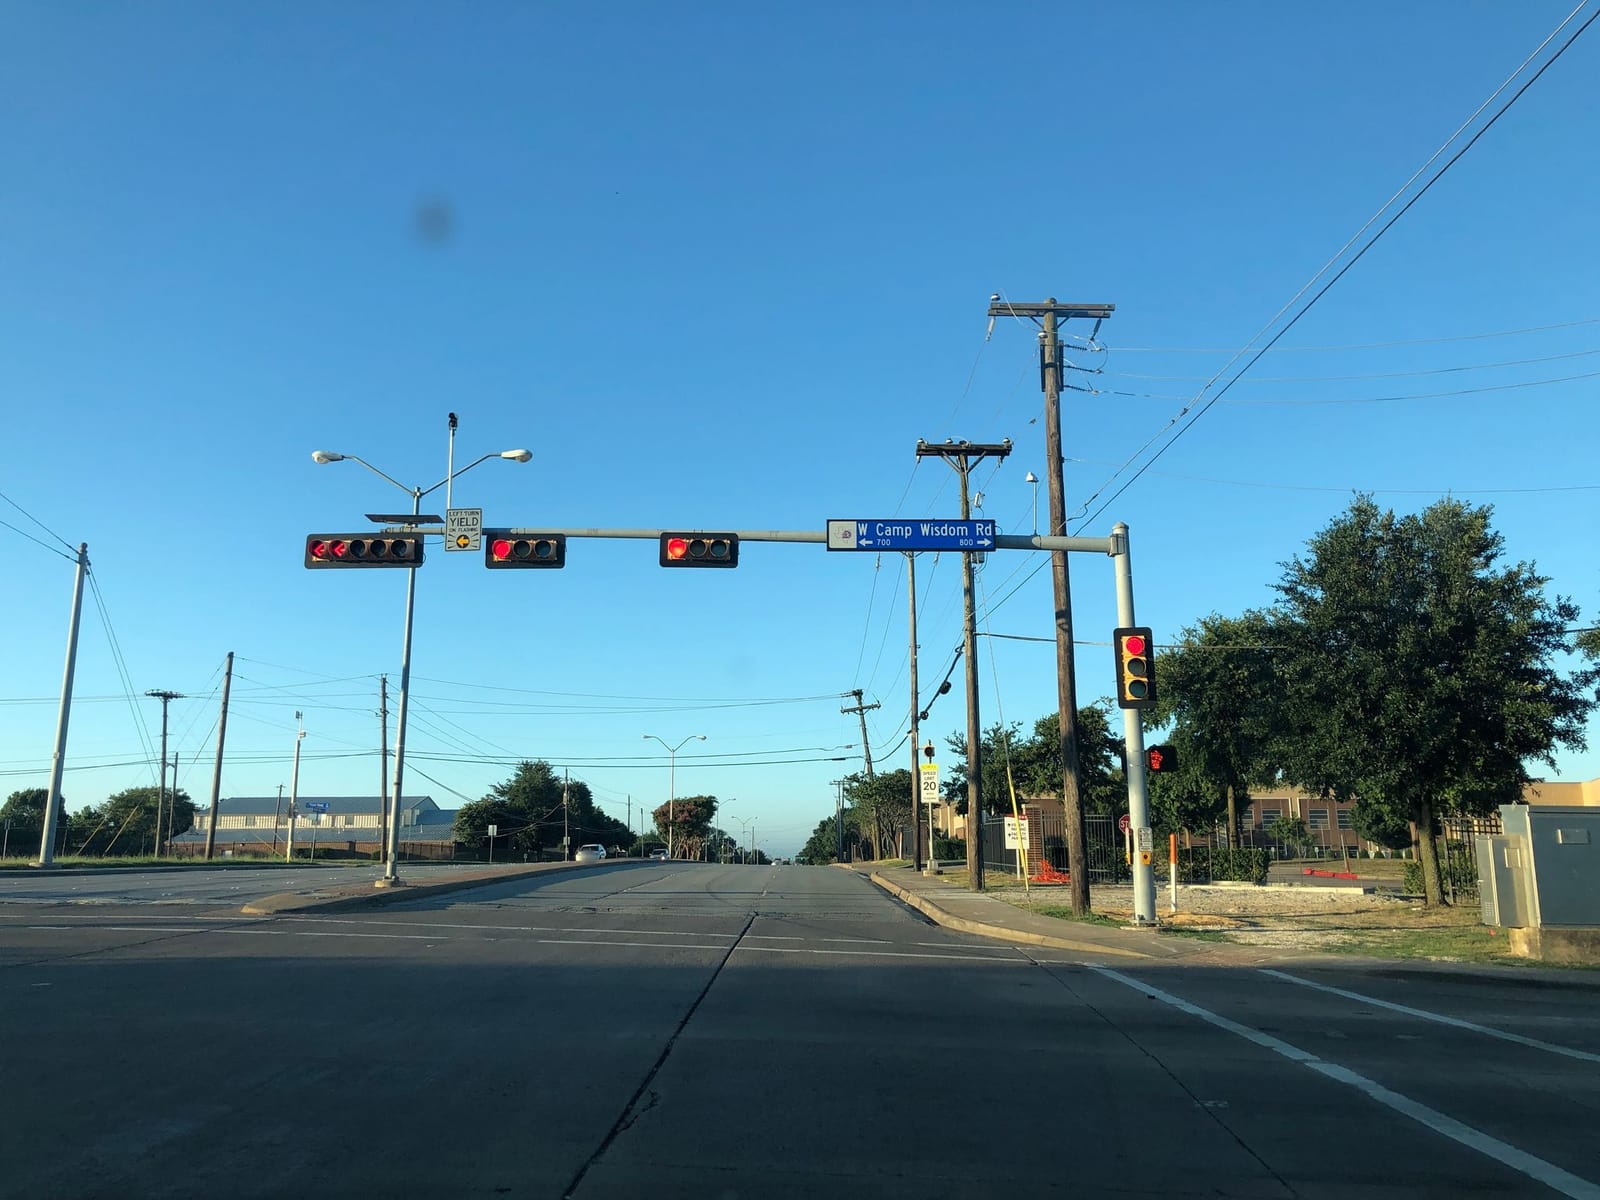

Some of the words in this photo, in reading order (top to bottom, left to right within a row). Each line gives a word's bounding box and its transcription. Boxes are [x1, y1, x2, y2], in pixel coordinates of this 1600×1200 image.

[450, 517, 478, 526] YIELD
[857, 523, 868, 536] W
[876, 523, 912, 539] Camp
[920, 523, 968, 537] Wisdom
[975, 523, 992, 537] Rd
[923, 781, 937, 791] 20
